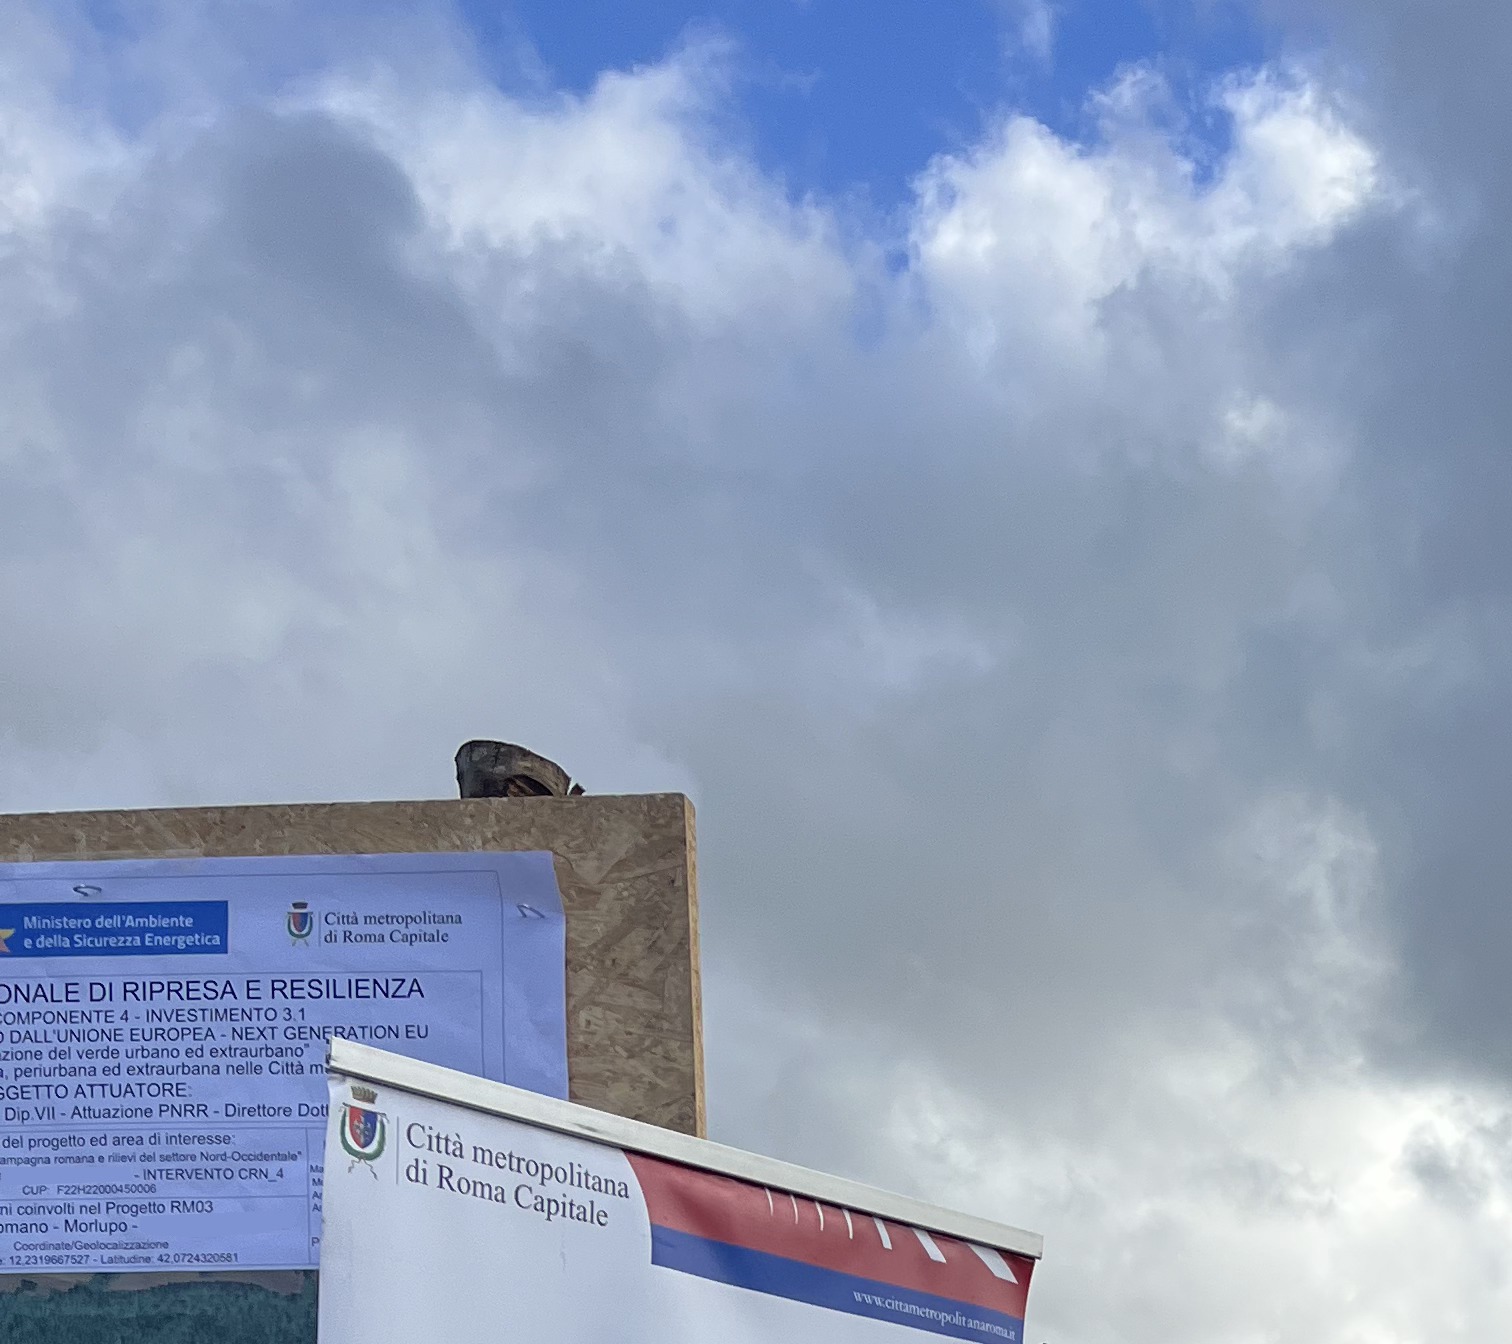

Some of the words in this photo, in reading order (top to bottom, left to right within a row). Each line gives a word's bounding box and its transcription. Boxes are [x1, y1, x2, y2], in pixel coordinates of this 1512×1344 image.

[23, 916, 91, 929] Ministero
[95, 914, 194, 928] dell'Ambiente
[324, 911, 359, 926] Città
[364, 910, 463, 928] metropolitana
[23, 938, 33, 949] e
[35, 935, 71, 949] della
[73, 934, 141, 948] Sicurezza
[145, 932, 221, 949] Energetica
[324, 930, 338, 944] di
[342, 930, 385, 944] Roma
[389, 929, 449, 946] Capitale
[89, 981, 113, 1003] DI
[123, 980, 238, 1002] RIPRESA
[246, 979, 262, 1000] E
[271, 977, 425, 1000] RESILIENZA
[0, 1008, 115, 1025] OMPONENTE
[120, 1008, 129, 1022] 4
[146, 1007, 277, 1024] INVESTIMENTO
[283, 1007, 305, 1022] 3.1
[10, 1028, 124, 1044] DALL'UNIONE
[130, 1026, 216, 1042] EUROPEA
[232, 1025, 278, 1041] NEXT
[284, 1024, 399, 1041] GENERATION
[405, 1024, 428, 1039] EU
[0, 1047, 42, 1061] zione
[48, 1047, 71, 1060] del
[76, 1046, 119, 1060] verde
[125, 1045, 180, 1059] urbano
[184, 1045, 204, 1058] ed
[209, 1043, 309, 1058] extraurbano"
[14, 1063, 97, 1081] periurbana
[102, 1063, 120, 1076] ed
[126, 1061, 220, 1076] extraurbana
[226, 1062, 263, 1075] nelle
[268, 1060, 304, 1075] Città
[74, 1082, 192, 1099] ATTUATORE:
[4, 1106, 55, 1125] Dip.VII
[71, 1104, 153, 1119] Attuazione
[159, 1103, 209, 1118] PNRR
[225, 1103, 292, 1118] Direttore
[2, 1135, 23, 1149] del
[28, 1135, 86, 1151] progetto
[89, 1133, 107, 1147] ed
[112, 1135, 144, 1147] area
[149, 1132, 161, 1146] di
[165, 1132, 236, 1146] interesse:
[54, 1154, 95, 1164] romana
[98, 1155, 105, 1164] e
[108, 1153, 137, 1163] rilievi
[139, 1151, 156, 1163] del
[159, 1152, 197, 1162] settore
[406, 1123, 465, 1159] Città
[472, 1145, 630, 1199] metropolitana
[143, 1167, 234, 1181] INTERVENTO
[238, 1167, 284, 1183] CRN_4
[57, 1184, 157, 1195] F22H22000450006
[406, 1158, 428, 1186] di
[437, 1164, 507, 1205] Roma
[514, 1184, 609, 1227] Capitale
[17, 1202, 74, 1216] coinvolti
[79, 1202, 101, 1215] nel
[105, 1201, 165, 1217] Progetto
[171, 1200, 214, 1214] RM03
[64, 1219, 128, 1235] Morlupo
[13, 1240, 169, 1251] Coordinate/Geolocalizzazione
